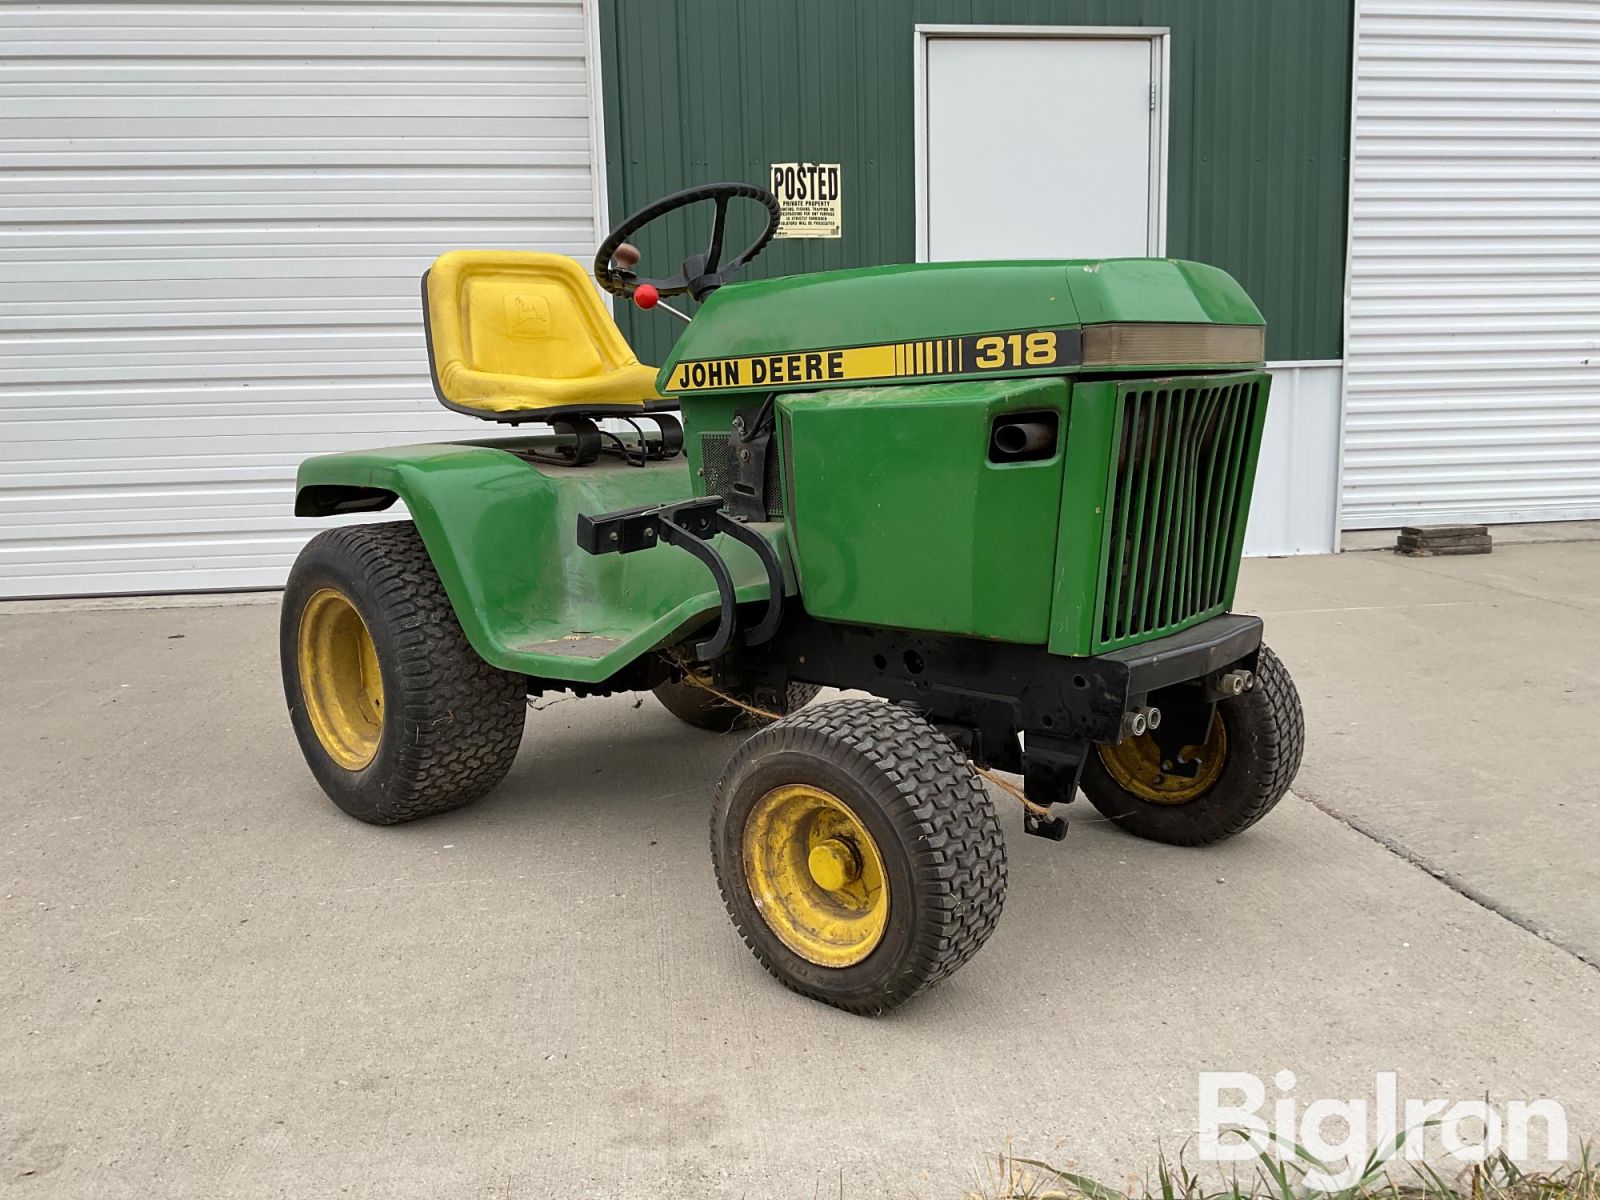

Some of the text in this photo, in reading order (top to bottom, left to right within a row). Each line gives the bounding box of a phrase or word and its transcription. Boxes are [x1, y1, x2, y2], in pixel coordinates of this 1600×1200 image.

[774, 167, 838, 200] POSTED
[679, 331, 1057, 388] JOHN DEERE 318
